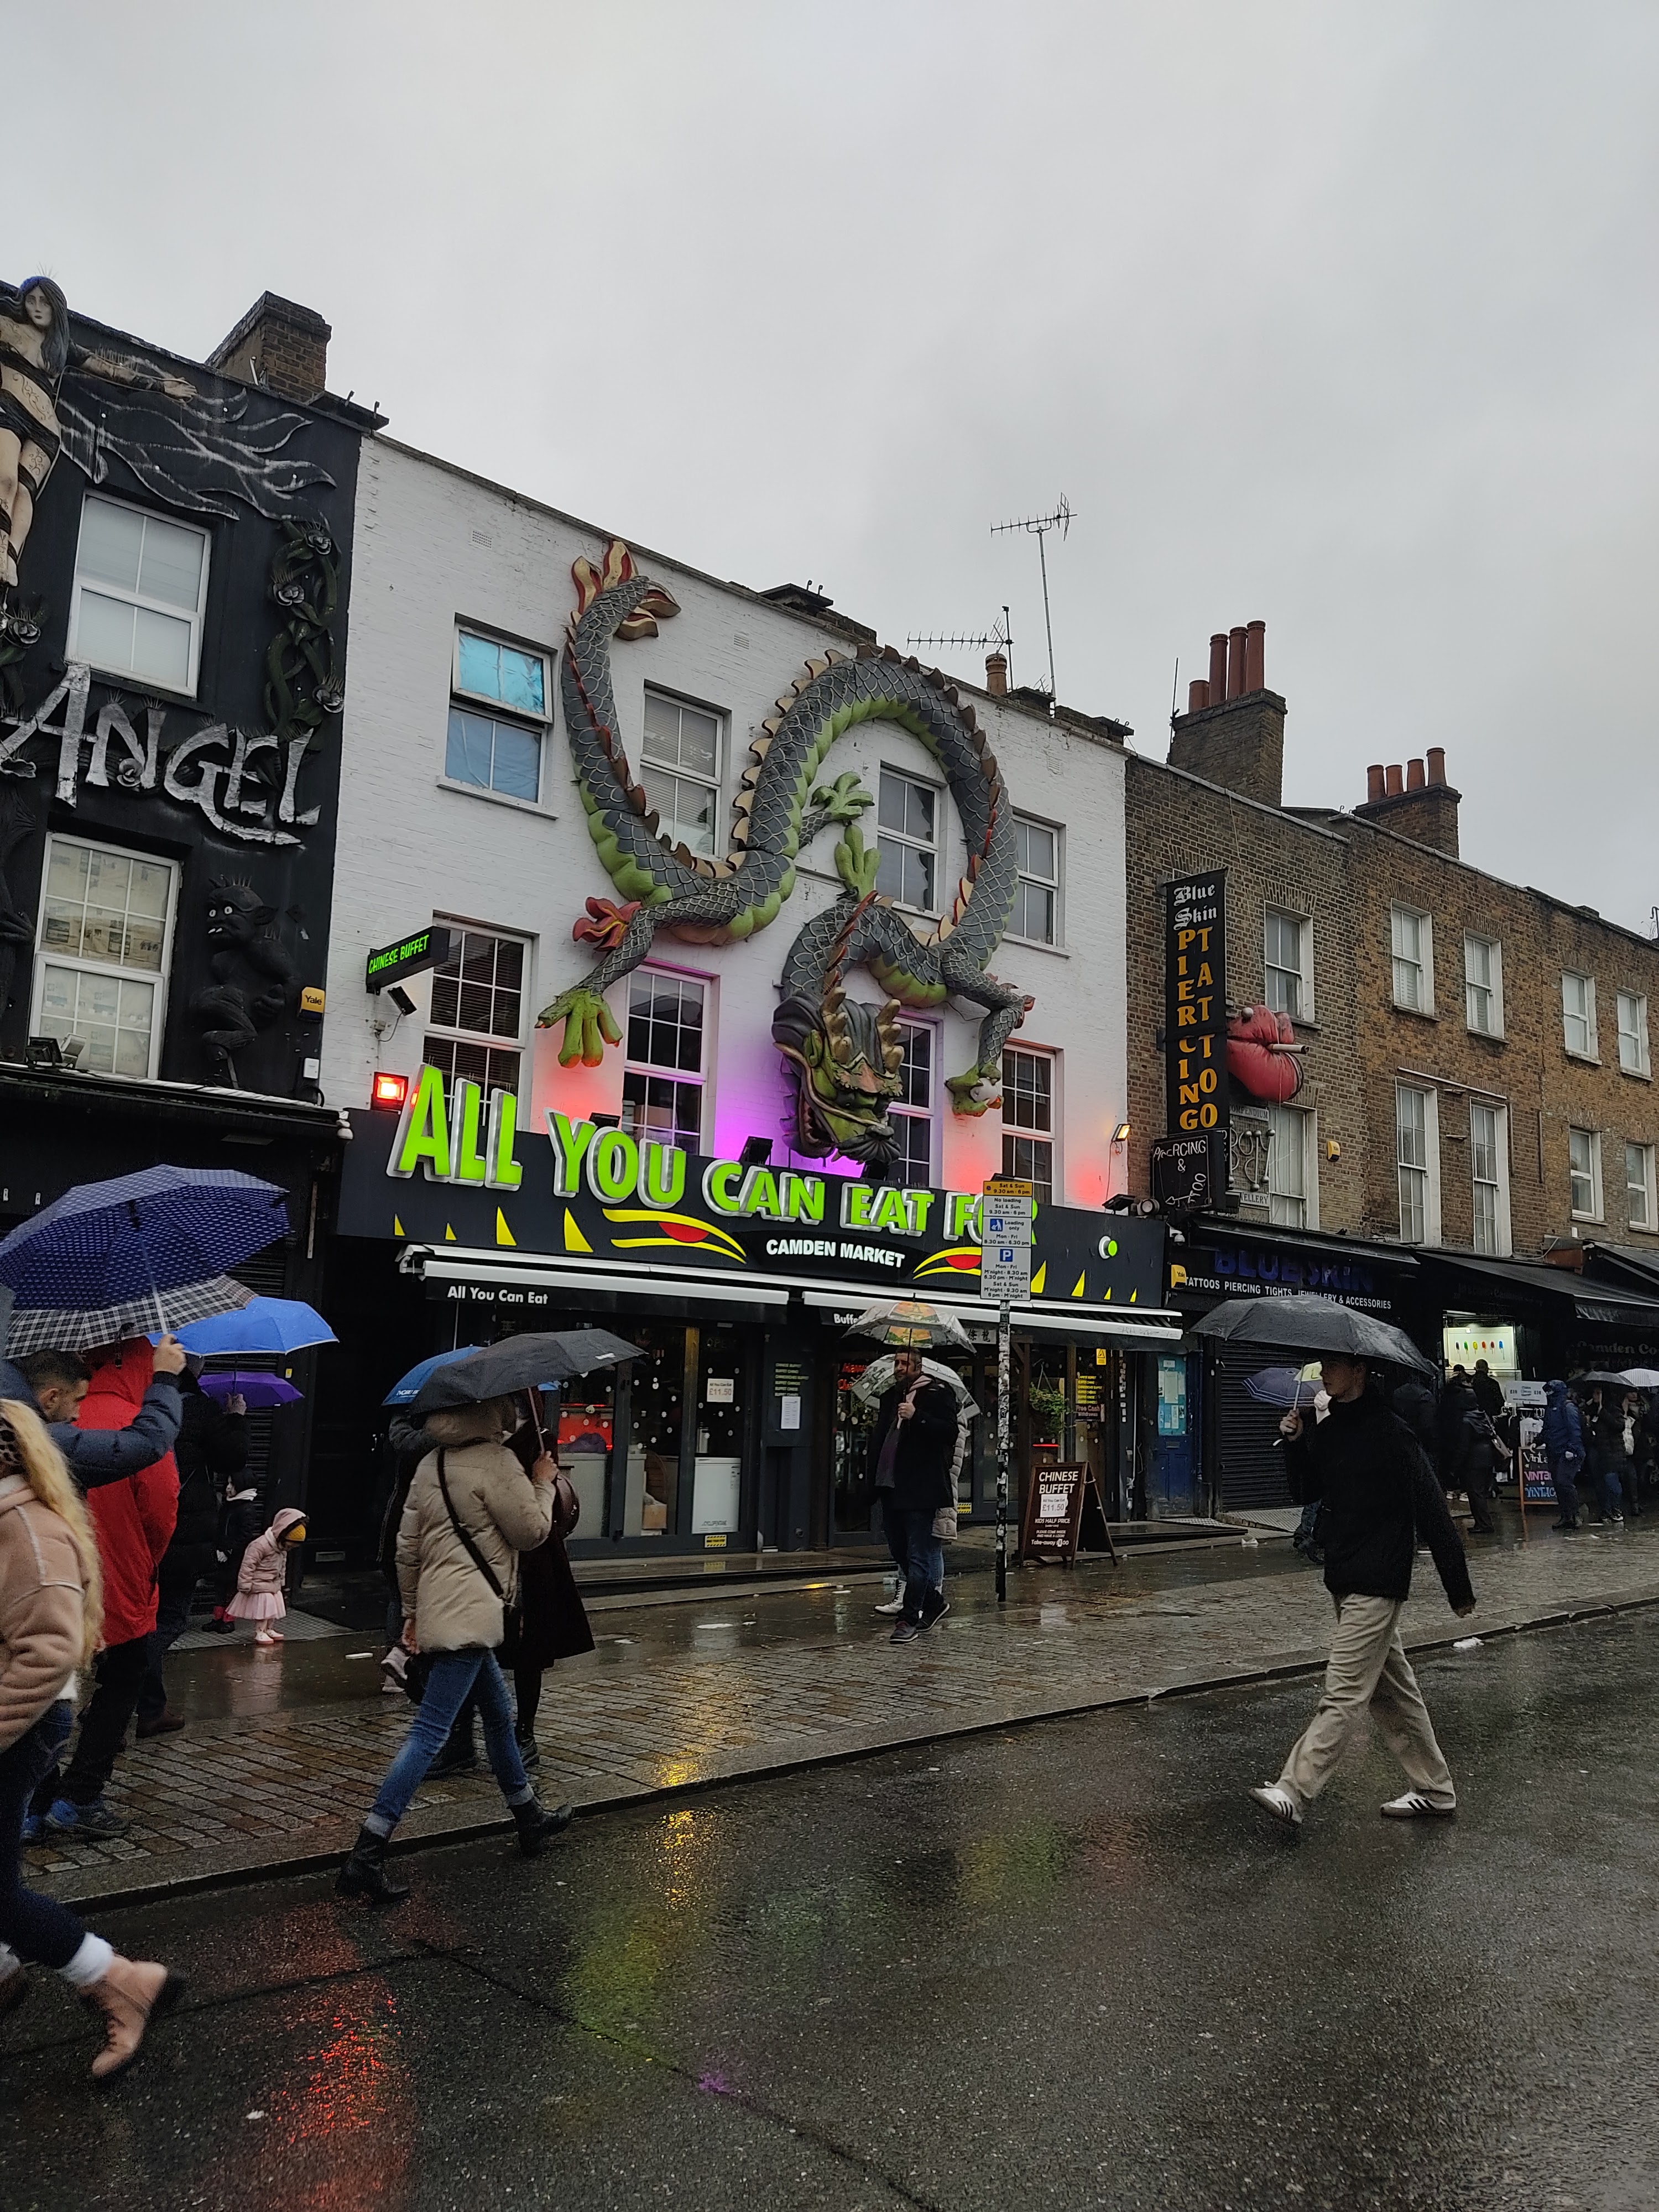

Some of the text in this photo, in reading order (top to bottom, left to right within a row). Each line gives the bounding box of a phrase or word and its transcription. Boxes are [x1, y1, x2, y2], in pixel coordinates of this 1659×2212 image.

[0, 663, 322, 845] ANGEL
[1173, 885, 1215, 906] Blue
[1173, 905, 1217, 930] Skin
[368, 934, 429, 974] CHINESE BUFFET
[305, 995, 322, 1005] Yale
[1231, 1105, 1268, 1119] OMPENDIUM
[387, 1063, 523, 1190] ALL
[544, 1107, 686, 1208] YOU
[702, 1159, 825, 1225] CAN
[840, 1182, 935, 1237] EAT
[1177, 1159, 1186, 1173] &
[1240, 1192, 1269, 1204] ELLERY
[766, 1239, 905, 1267] CAMDEN MARKET
[1003, 1250, 1011, 1261] P
[447, 1285, 548, 1304] All You Can Eat
[1186, 1277, 1391, 1310] TATTOOS PIERCING TIGHTS JEWERY & ACCESSORIES
[834, 1313, 858, 1324] Buffe
[1039, 1471, 1079, 1482] CHINESE
[1039, 1484, 1075, 1494] BUFFET
